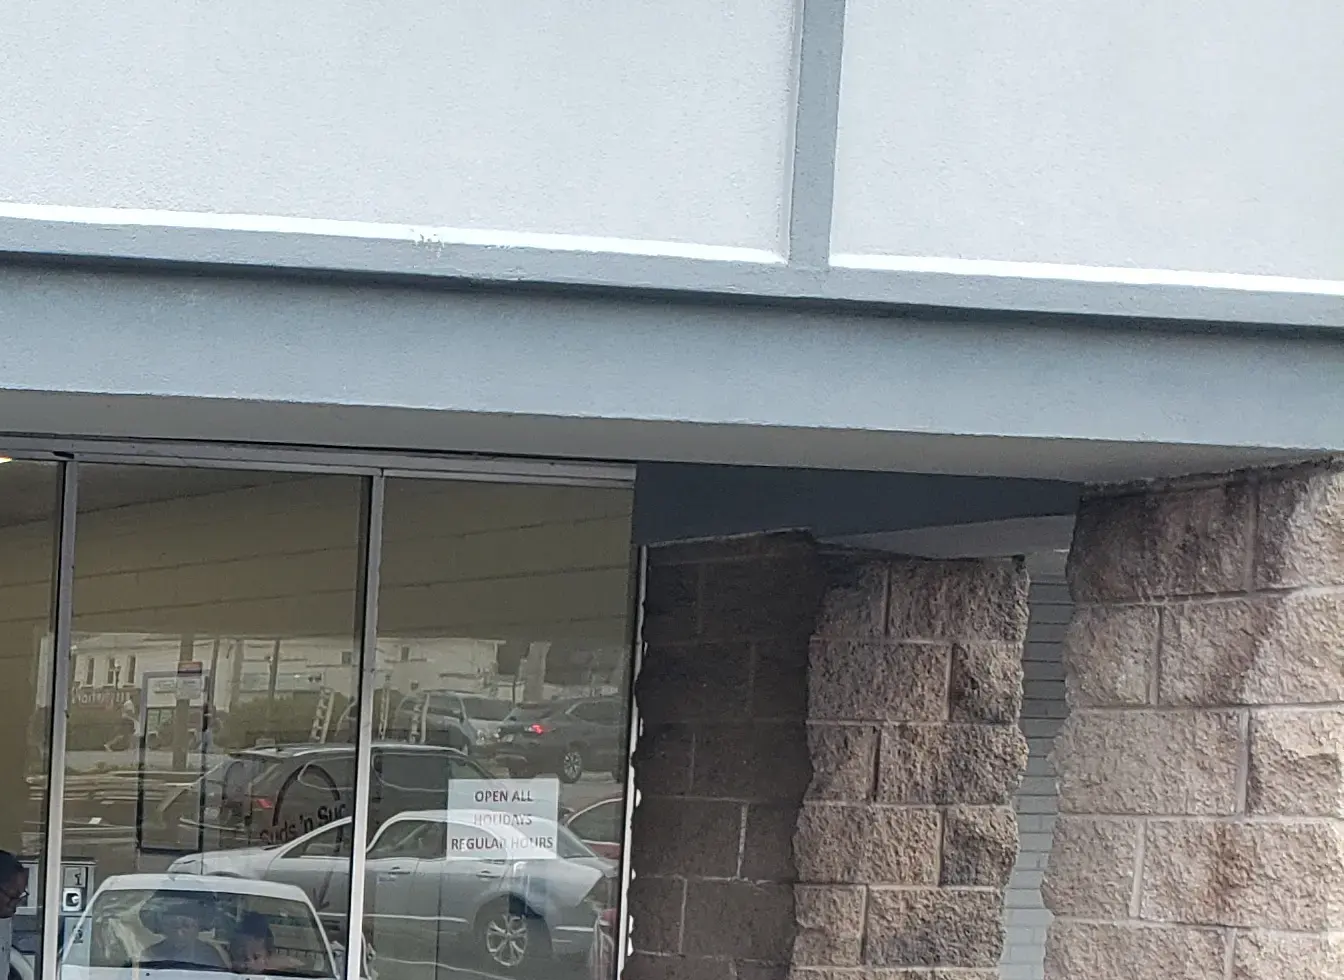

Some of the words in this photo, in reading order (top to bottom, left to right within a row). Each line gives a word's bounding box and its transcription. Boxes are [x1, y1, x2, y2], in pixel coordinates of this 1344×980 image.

[474, 790, 508, 803] OPEN
[511, 790, 533, 802] ALL
[473, 813, 533, 826] HOLIDAYS
[451, 837, 505, 850] REGULAR
[511, 837, 554, 849] HOURS
